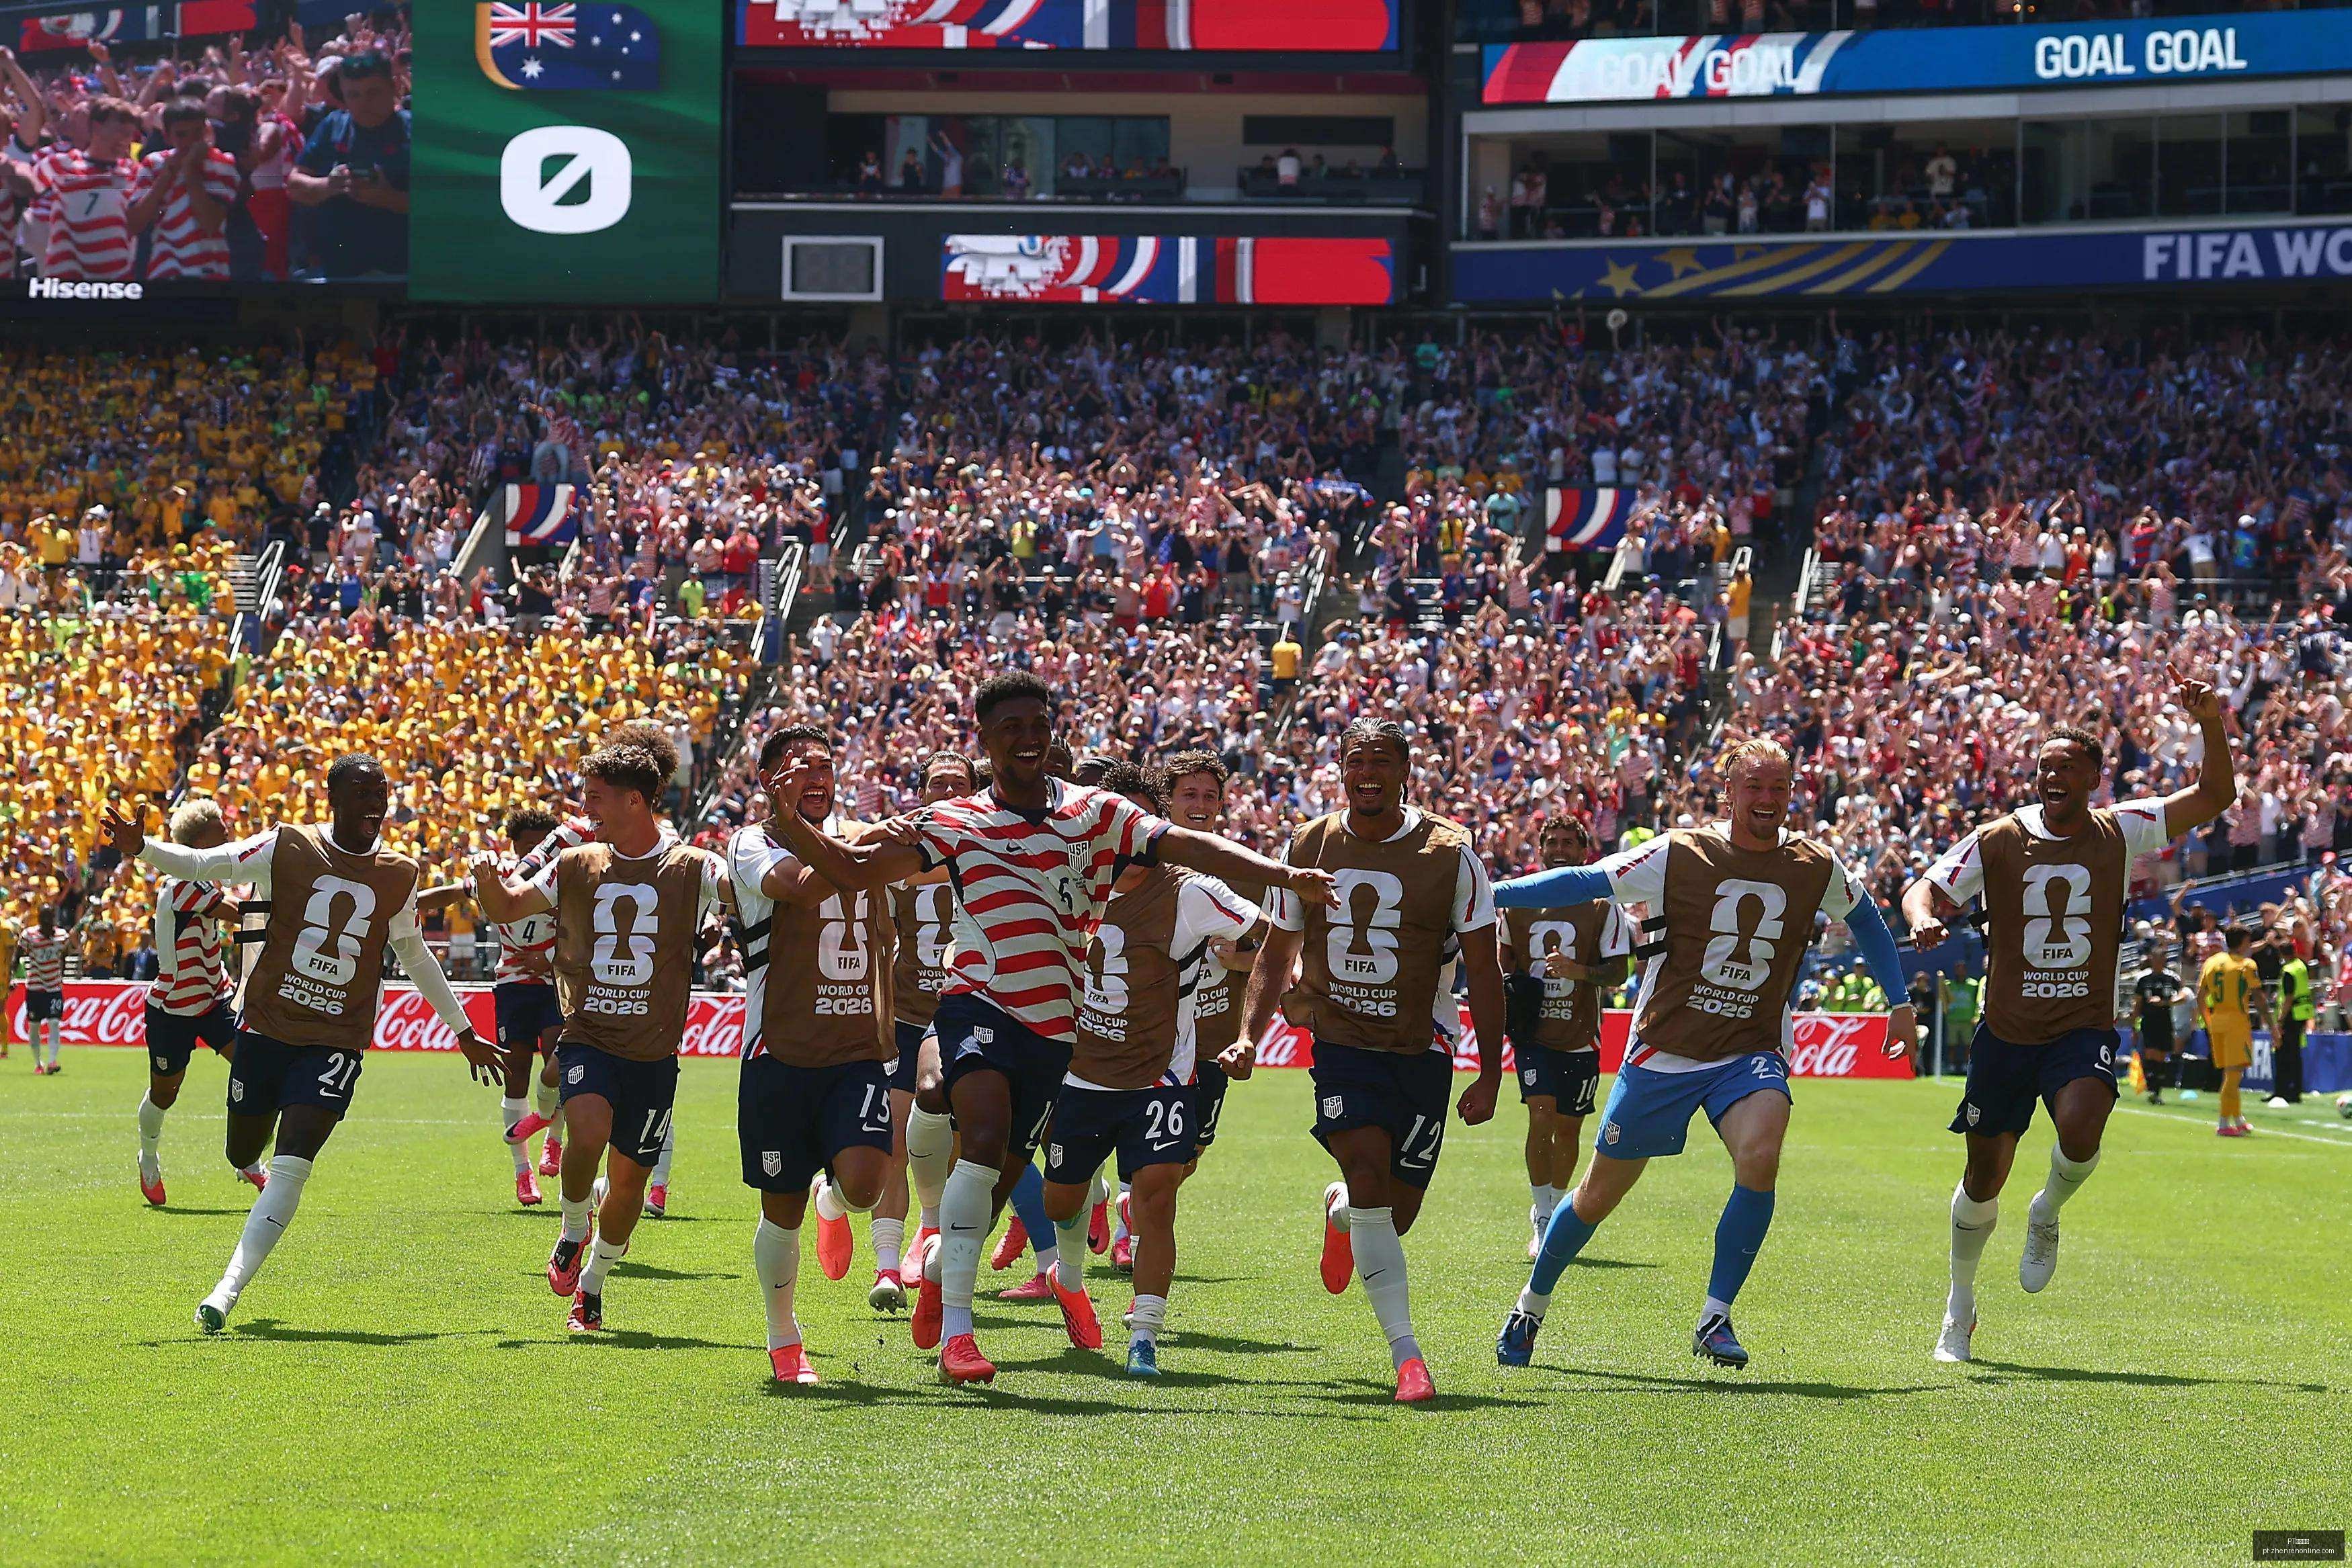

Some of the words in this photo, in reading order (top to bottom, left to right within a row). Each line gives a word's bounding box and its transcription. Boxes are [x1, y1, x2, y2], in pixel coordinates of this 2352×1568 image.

[2035, 33, 2136, 79] GOAL
[2145, 27, 2248, 74] GOAL
[1706, 44, 1804, 91] GOAL
[85, 191, 99, 215] 7
[2144, 232, 2265, 281] FIFA
[29, 277, 144, 300] Hisense
[1068, 842, 1088, 856] USA
[522, 920, 536, 943] 4
[2043, 948, 2074, 959] FIFA
[308, 957, 339, 975] FIFA
[607, 964, 637, 976] FIFA
[838, 957, 860, 969] FIFA
[1344, 959, 1378, 973] FIFA
[1720, 965, 1751, 981] FIFA
[2023, 971, 2065, 982] WORLD
[2067, 971, 2089, 981] CUP
[284, 972, 325, 994] WORLD
[325, 988, 347, 1000] CUP
[588, 985, 627, 999] WORLD
[629, 989, 650, 999] CUP
[817, 985, 853, 996] WORLD
[855, 984, 869, 996] CUP
[1210, 986, 1229, 1000] CUP
[1329, 982, 1369, 998] WORLD
[1371, 988, 1397, 999] CUP
[1693, 984, 1736, 1001] WORLD
[1737, 994, 1759, 1004] CUP
[2022, 982, 2089, 998] 2026
[2214, 971, 2224, 1002] 5
[278, 984, 345, 1016] 2026
[583, 997, 648, 1016] 2026
[814, 998, 873, 1015] 2026
[1556, 1000, 1573, 1008] CUP
[1686, 995, 1753, 1019] 2026
[975, 1026, 993, 1035] USA
[1104, 1016, 1128, 1028] CUP
[2099, 1045, 2111, 1066] 6
[318, 1052, 357, 1090] 21
[569, 1065, 583, 1076] USA
[1577, 1076, 1597, 1103] 10
[859, 1084, 891, 1124] 15
[1324, 1096, 1341, 1108] USA
[640, 1108, 671, 1143] 14
[1145, 1100, 1184, 1140] 26
[1401, 1115, 1441, 1162] 12
[763, 1151, 780, 1163] USA
